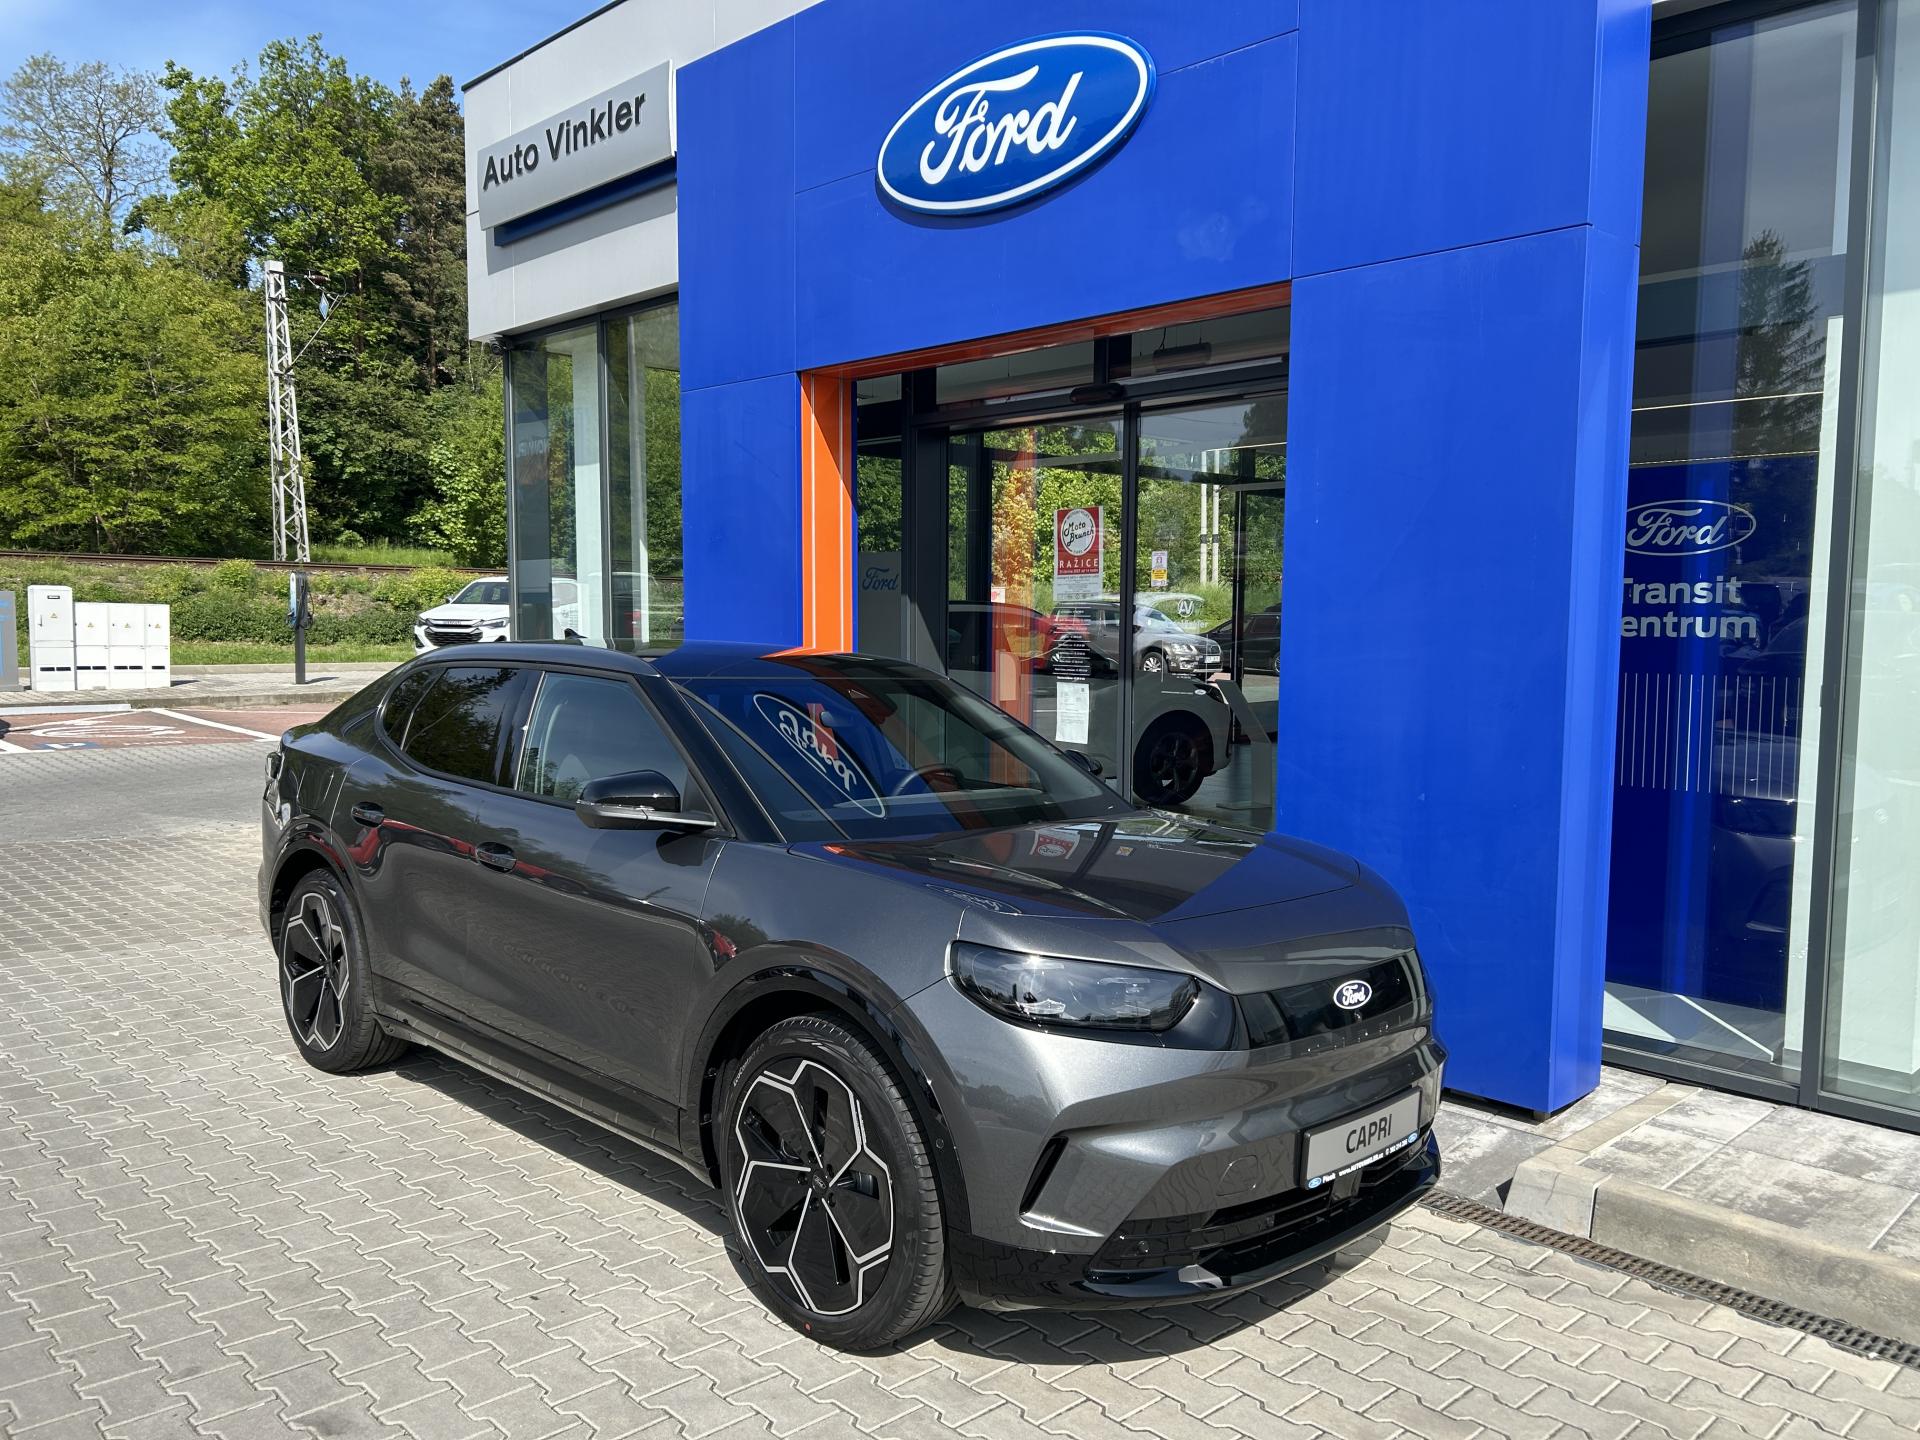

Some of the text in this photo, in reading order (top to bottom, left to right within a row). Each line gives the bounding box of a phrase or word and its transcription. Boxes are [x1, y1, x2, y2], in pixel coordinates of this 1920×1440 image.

[483, 93, 646, 192] Auto Vinkler
[919, 64, 1084, 185] Ford
[1627, 508, 1727, 547] Ford
[862, 566, 900, 591] Ford
[1059, 557, 1099, 569] RAŽICE
[1341, 984, 1367, 1006] Ford
[1346, 1114, 1392, 1153] CAPRI
